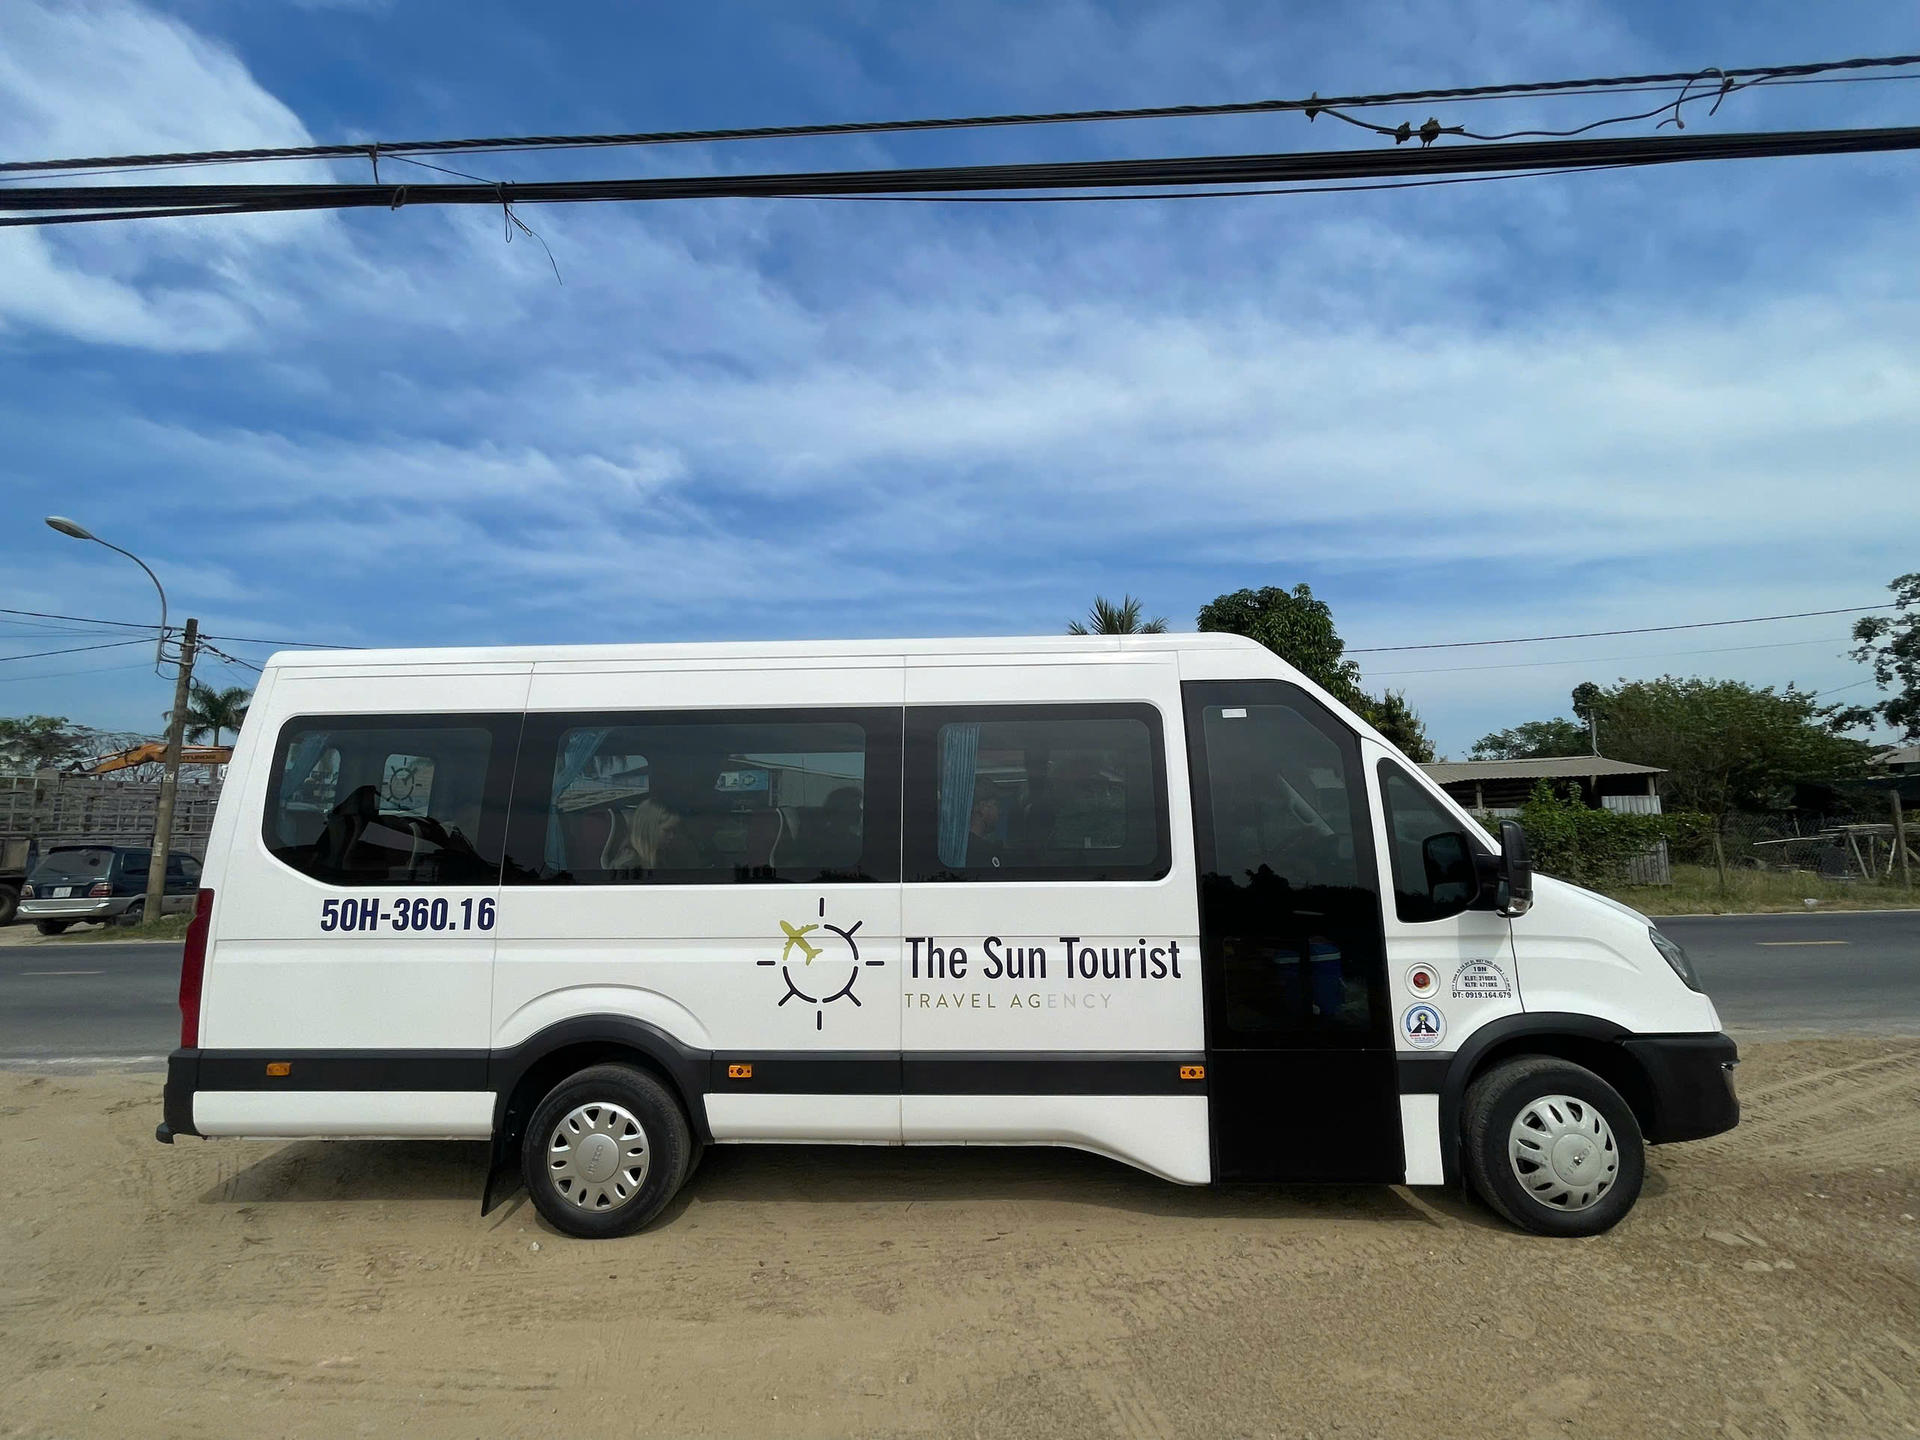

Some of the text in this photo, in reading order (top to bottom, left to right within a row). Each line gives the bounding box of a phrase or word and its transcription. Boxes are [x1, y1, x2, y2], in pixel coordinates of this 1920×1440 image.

[320, 897, 496, 932] 50H-360.16
[905, 936, 1182, 979] The Sun Tourist
[905, 993, 1113, 1009] TRAVEL AGENCY
